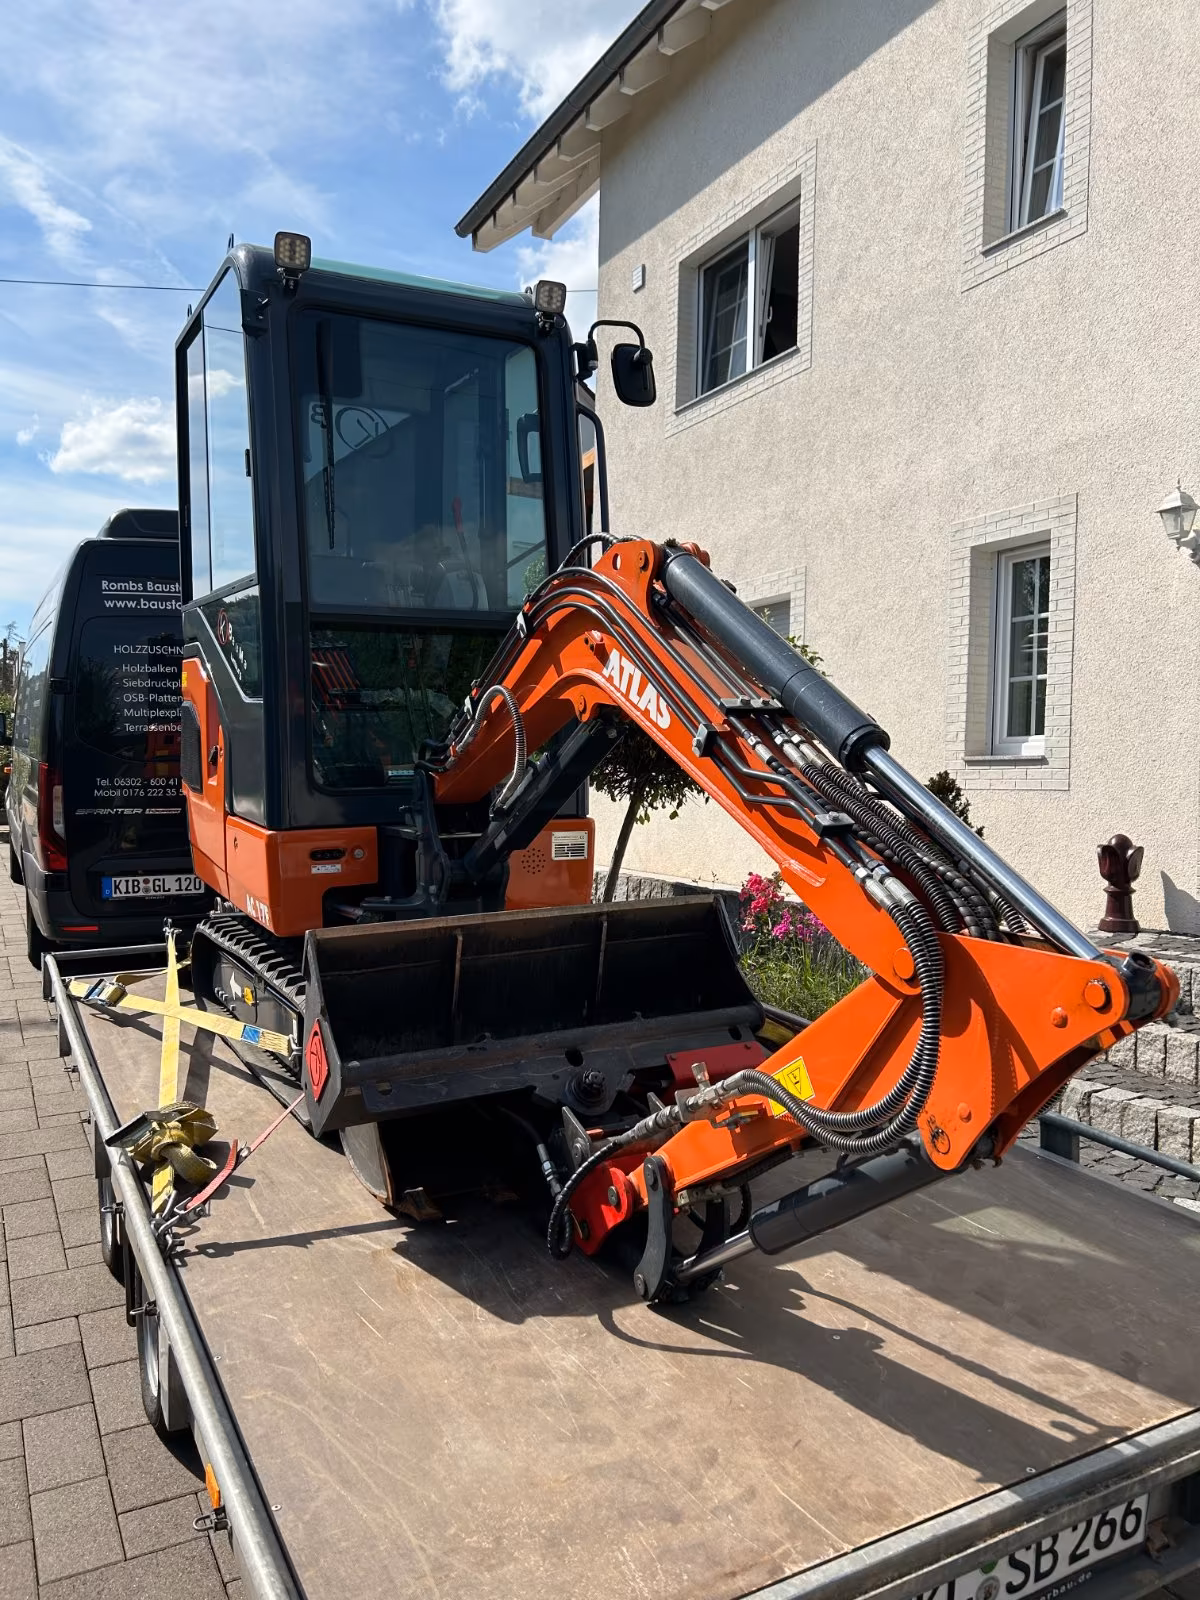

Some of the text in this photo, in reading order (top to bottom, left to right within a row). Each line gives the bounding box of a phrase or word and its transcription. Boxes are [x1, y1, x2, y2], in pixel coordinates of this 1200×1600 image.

[101, 580, 143, 591] Rombs
[113, 645, 184, 655] HOLZZUSCHN
[122, 664, 178, 673] Holzbalken
[122, 678, 182, 690] Siebdruckpl
[602, 648, 671, 730] ATLAS
[123, 693, 184, 702] OSB-Platten
[96, 778, 111, 786] Tel.
[114, 778, 142, 786] 06302
[150, 778, 167, 786] 600
[169, 778, 178, 786] 41
[94, 788, 121, 797] Mobil
[122, 788, 145, 797] 0176
[147, 788, 164, 797] 222
[167, 788, 177, 796] 35
[113, 876, 201, 895] KIB GL 120
[1005, 1500, 1143, 1594] SB 266
